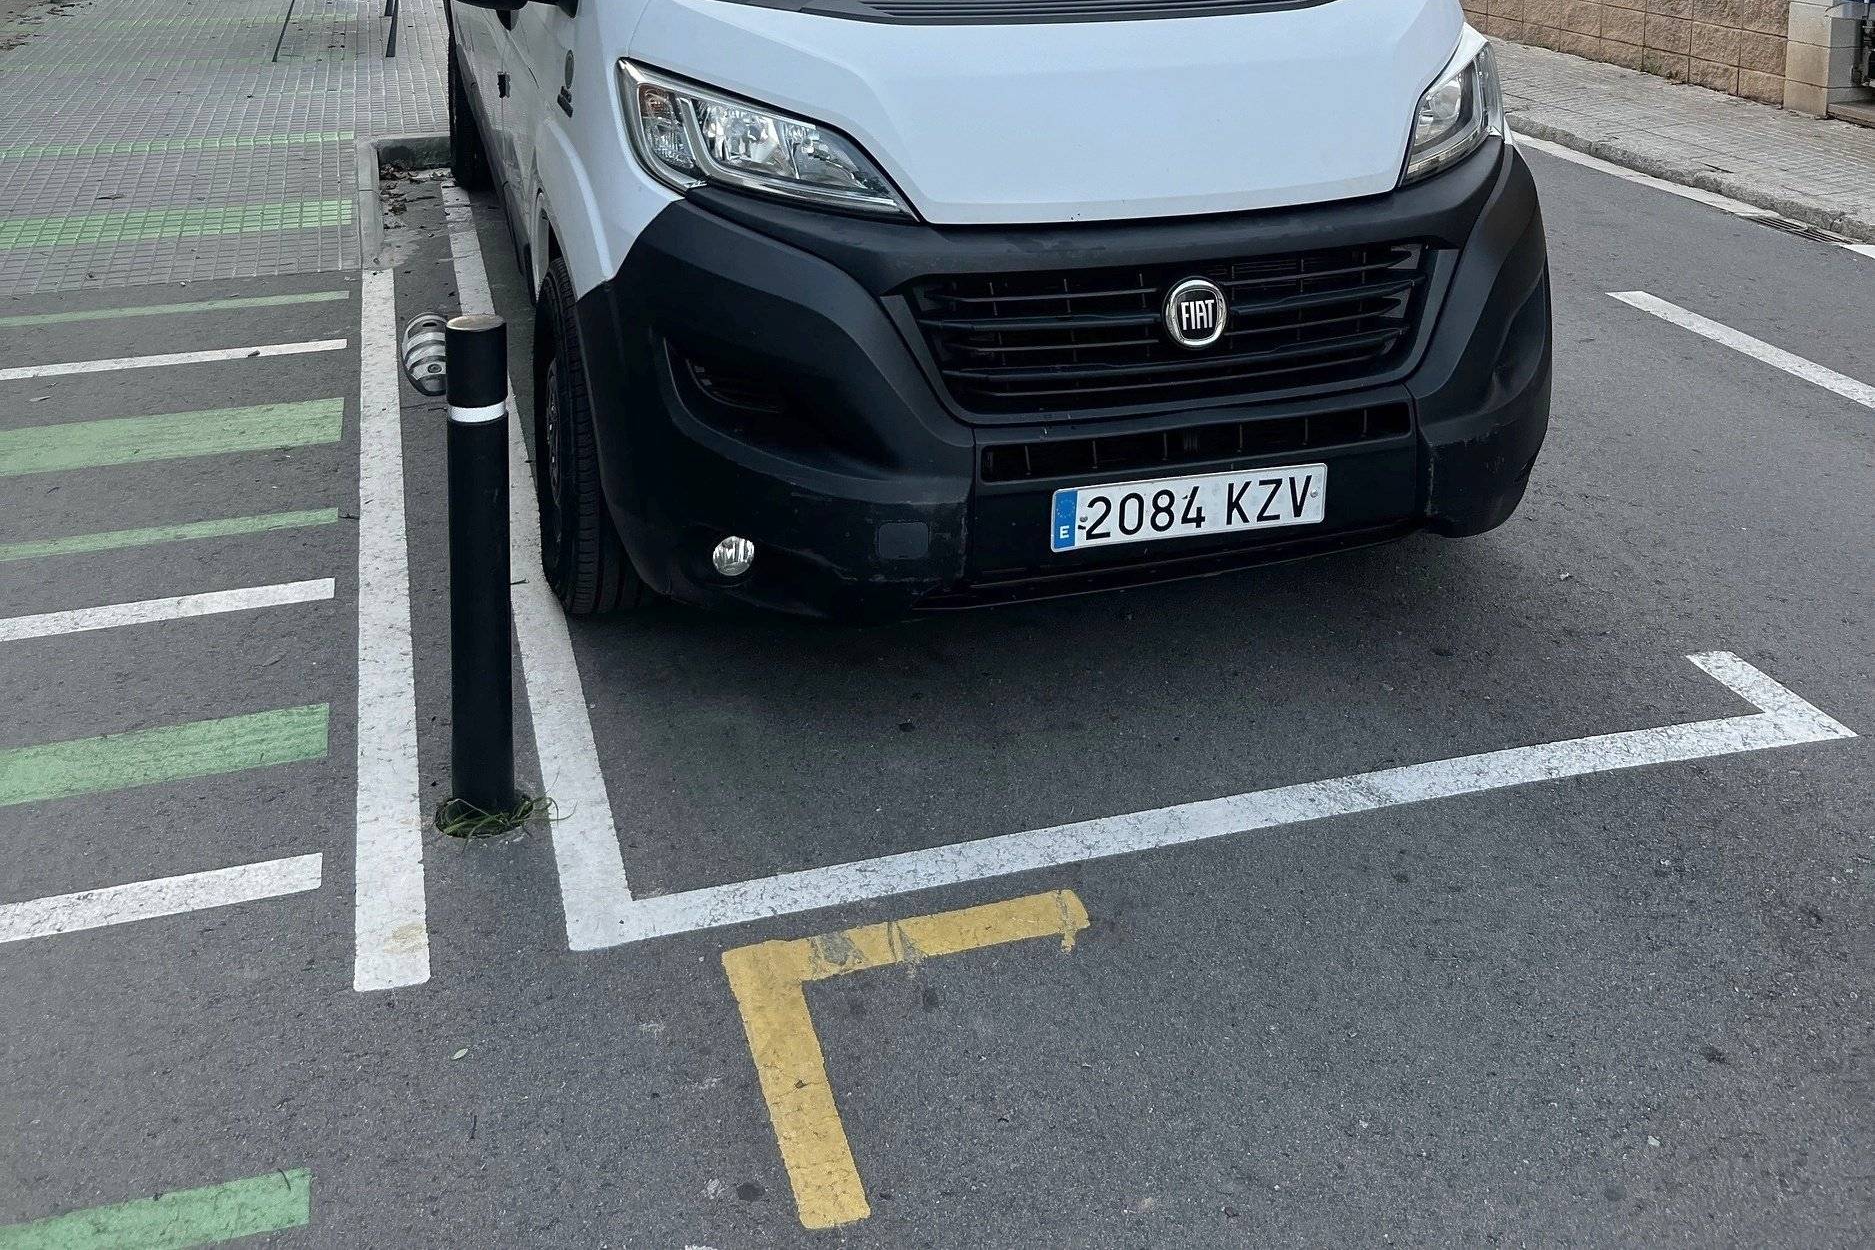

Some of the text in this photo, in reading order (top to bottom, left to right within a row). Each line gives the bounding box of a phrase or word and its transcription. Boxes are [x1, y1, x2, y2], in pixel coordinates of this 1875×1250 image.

[1181, 299, 1215, 330] FIAT
[1059, 474, 1313, 540] E 2084 KZV
